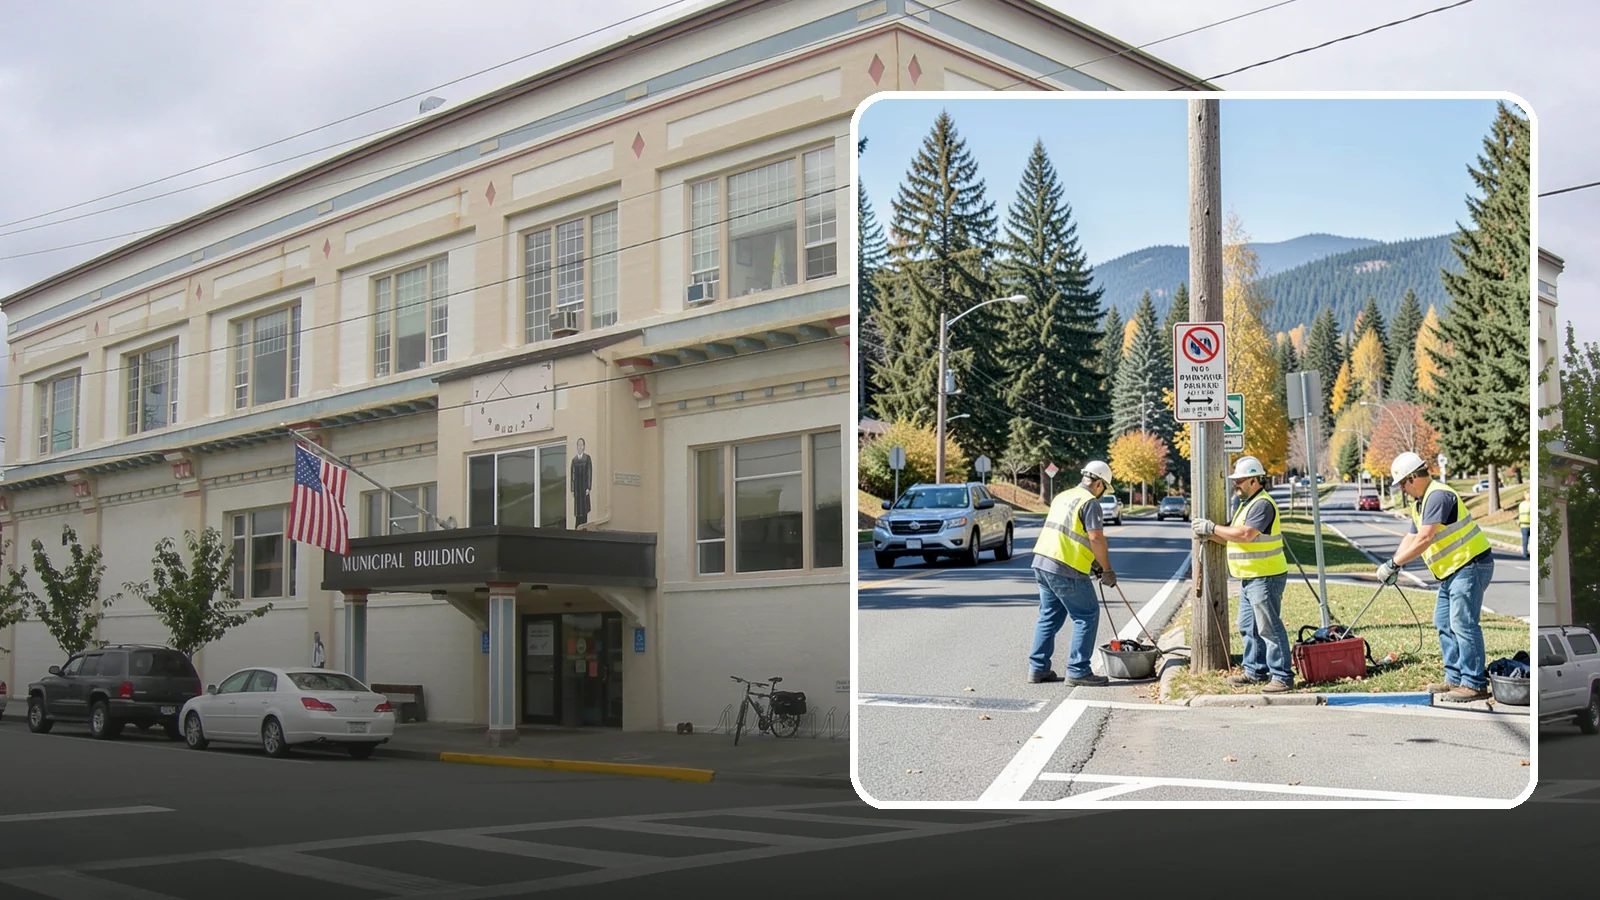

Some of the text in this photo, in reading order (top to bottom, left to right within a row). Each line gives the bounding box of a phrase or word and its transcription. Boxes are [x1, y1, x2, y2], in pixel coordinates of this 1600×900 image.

[475, 390, 479, 398] 7
[480, 407, 485, 415] 8
[487, 417, 492, 426] 9
[494, 423, 500, 431] 10
[507, 425, 513, 433] 12
[521, 420, 526, 428] 2
[529, 414, 533, 422] 3
[535, 402, 540, 410] 4
[342, 546, 475, 572] MUNICIPAL BUILDING
